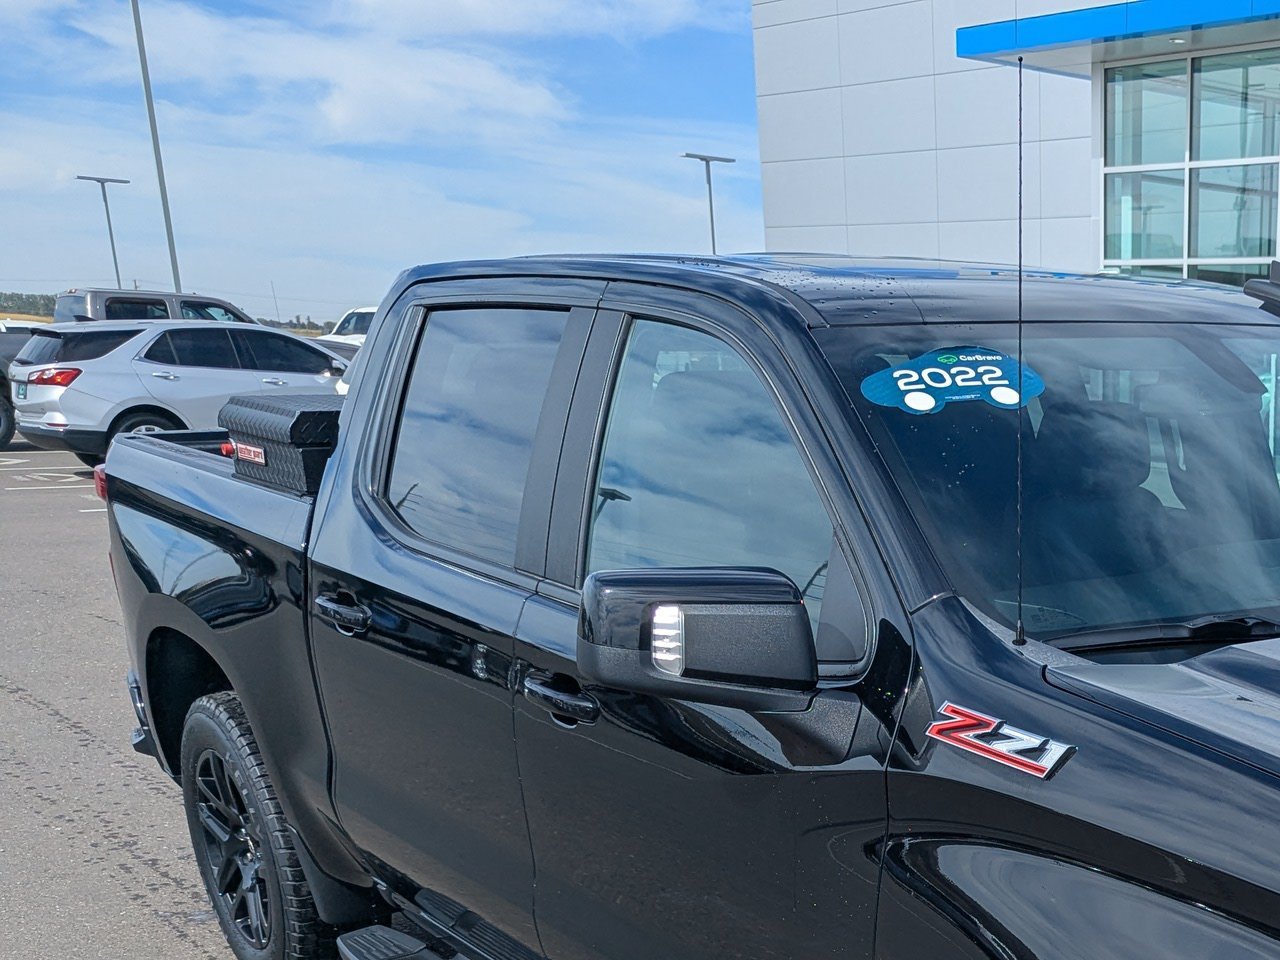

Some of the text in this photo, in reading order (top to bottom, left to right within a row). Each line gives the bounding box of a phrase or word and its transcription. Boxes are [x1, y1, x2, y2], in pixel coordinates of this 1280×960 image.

[959, 354, 1003, 363] CarBravo
[892, 365, 1010, 391] 2022
[924, 700, 1078, 780] Z71
